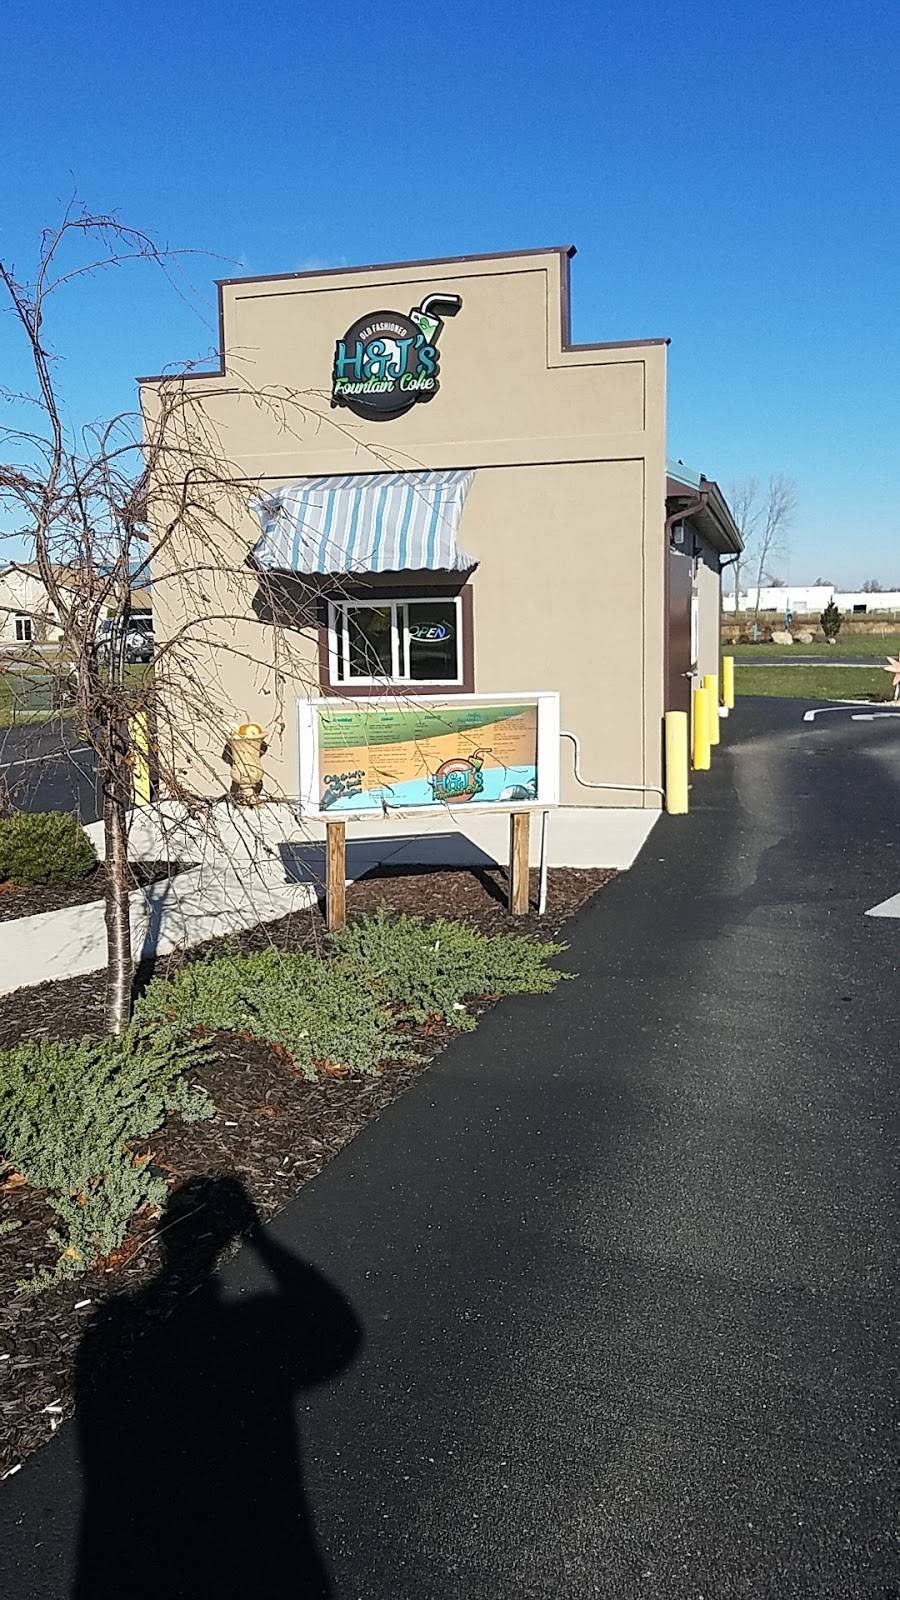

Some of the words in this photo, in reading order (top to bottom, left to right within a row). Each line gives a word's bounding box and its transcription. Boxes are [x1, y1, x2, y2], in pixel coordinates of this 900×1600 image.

[359, 327, 373, 340] OLD
[371, 322, 408, 337] FASHIONED
[336, 334, 436, 380] H&J's
[334, 375, 395, 395] Fountain
[399, 370, 435, 391] Coke
[408, 625, 446, 639] OPEN
